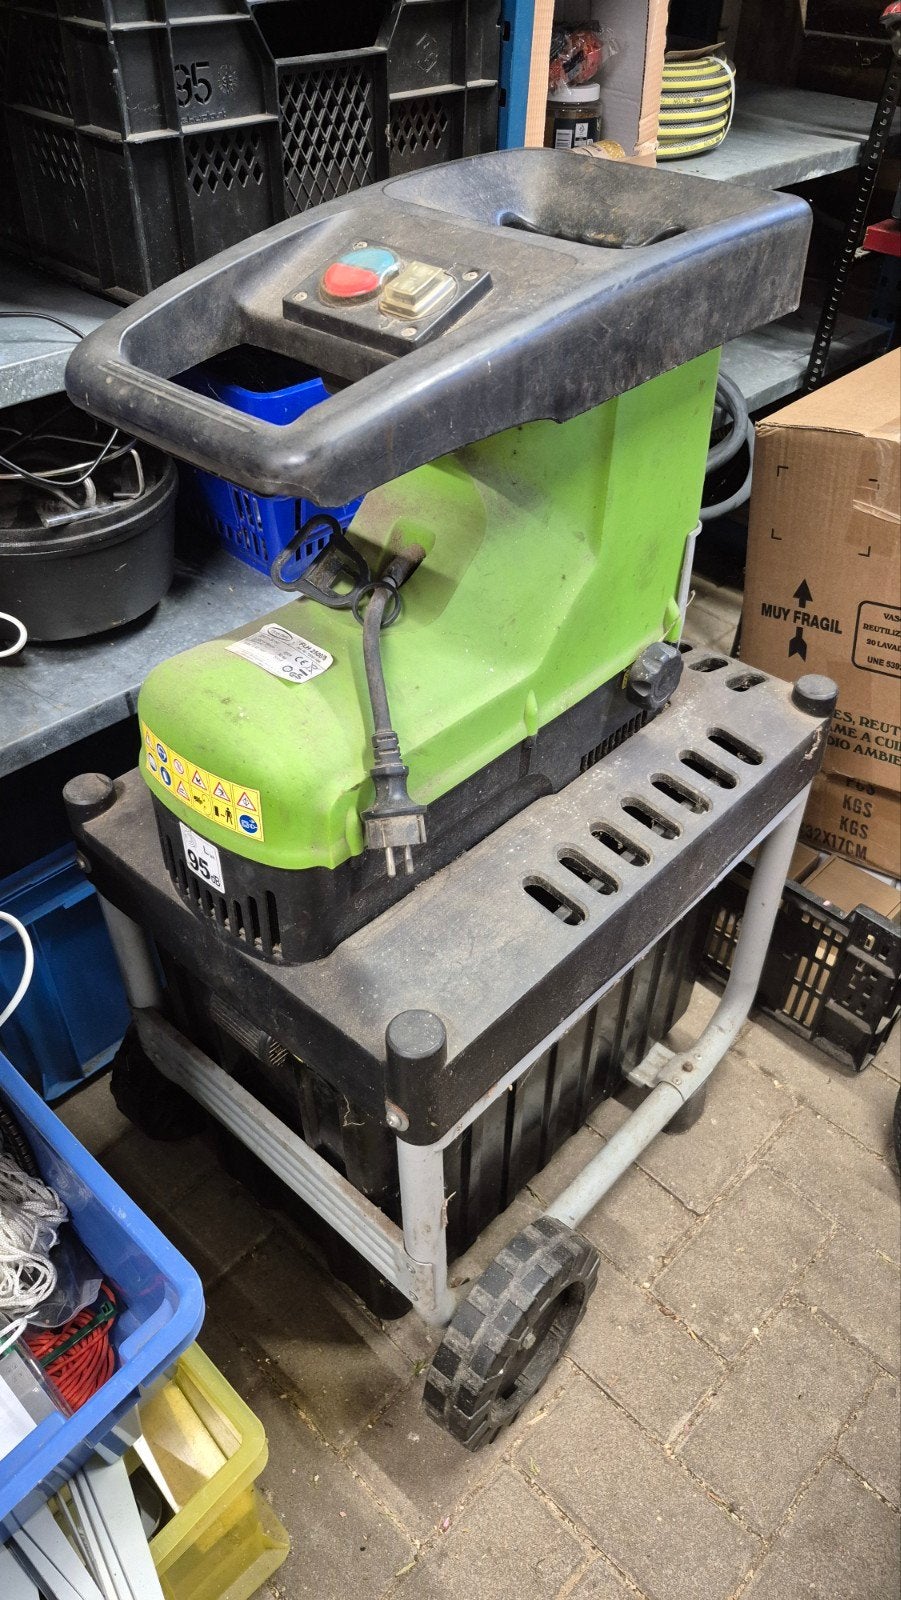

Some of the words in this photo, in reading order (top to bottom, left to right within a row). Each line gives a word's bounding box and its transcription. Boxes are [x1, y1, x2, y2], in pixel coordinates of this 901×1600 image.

[761, 603, 790, 621] MUY
[793, 611, 843, 635] FRAGIL
[883, 613, 901, 623] VAS
[863, 623, 901, 638] REUTILIZ
[866, 638, 877, 646] 20
[295, 656, 308, 665] CE
[867, 656, 885, 667] UNE
[886, 661, 901, 671] 539
[860, 732, 871, 743] A
[875, 736, 901, 751] CUI
[842, 794, 873, 818] KGS
[839, 815, 869, 840] KGS
[187, 849, 210, 880] 95
[210, 875, 221, 887] dB
